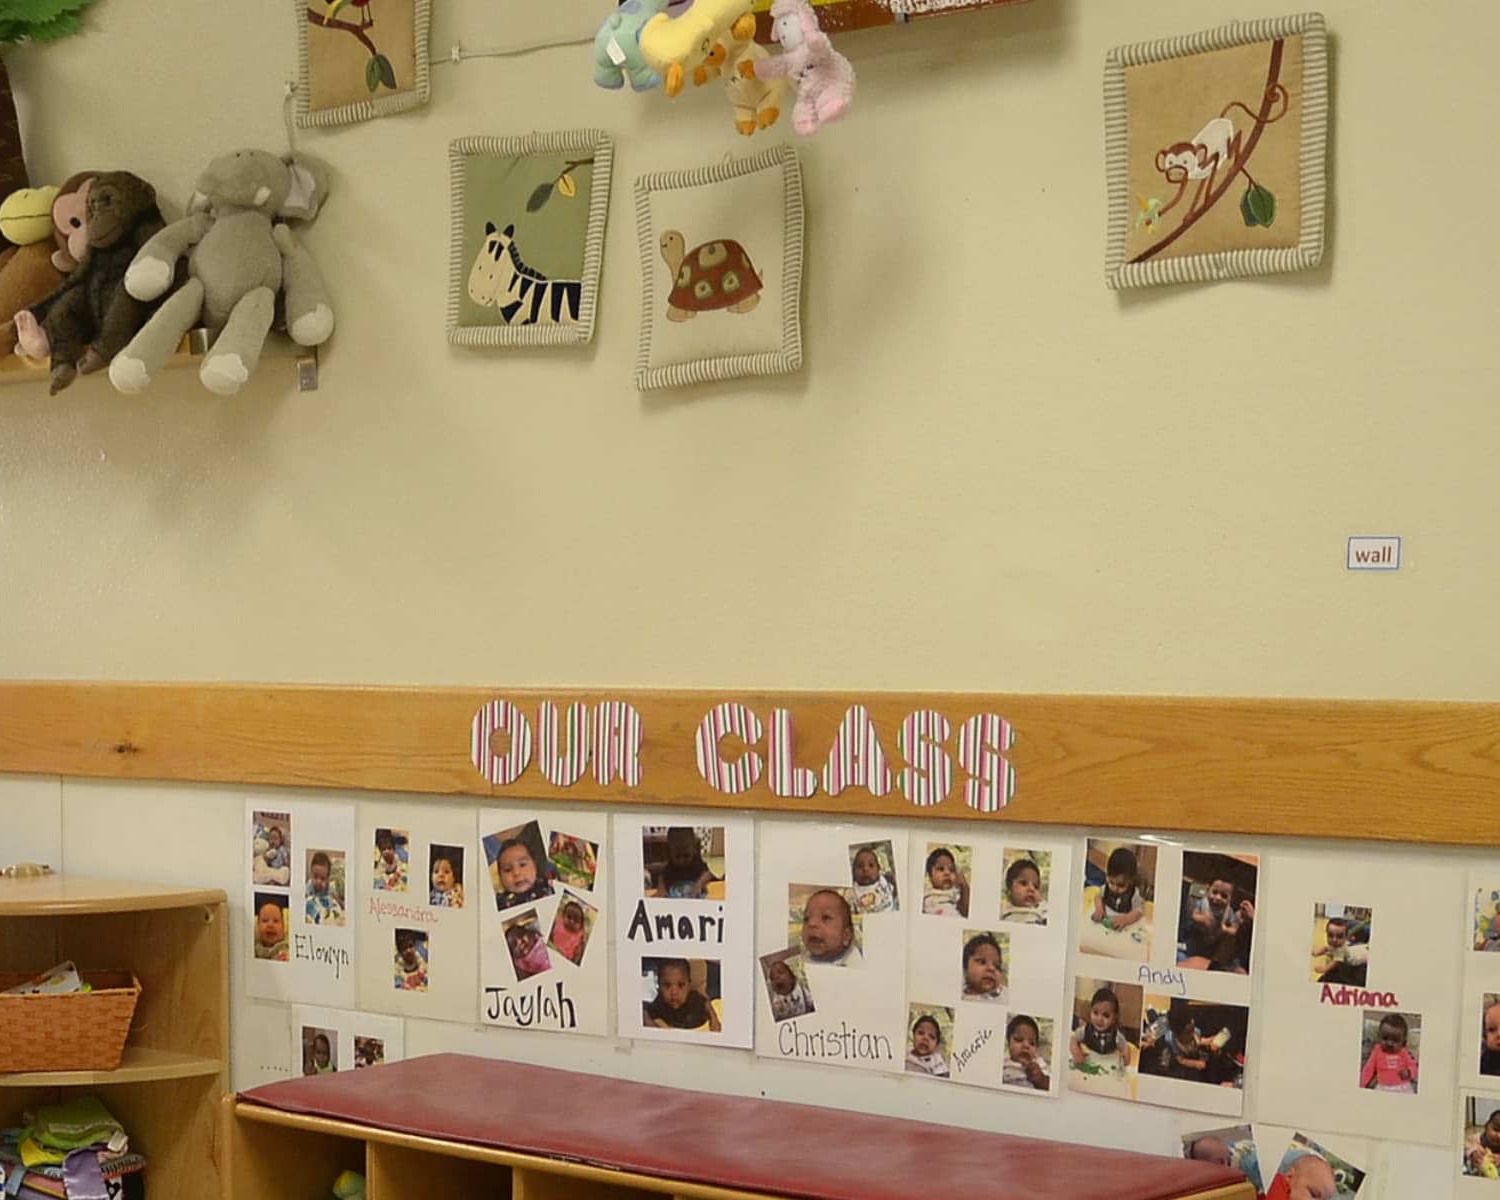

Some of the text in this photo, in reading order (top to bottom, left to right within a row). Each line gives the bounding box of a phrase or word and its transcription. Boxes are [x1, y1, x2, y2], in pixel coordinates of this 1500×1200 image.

[1355, 545, 1392, 564] wall
[469, 699, 1017, 813] OUR CLASS
[626, 899, 726, 944] Amari
[1137, 964, 1187, 995] Andy
[1319, 983, 1399, 1008] Adriana
[484, 981, 578, 1030] Jaylah
[778, 1020, 893, 1060] Christian
